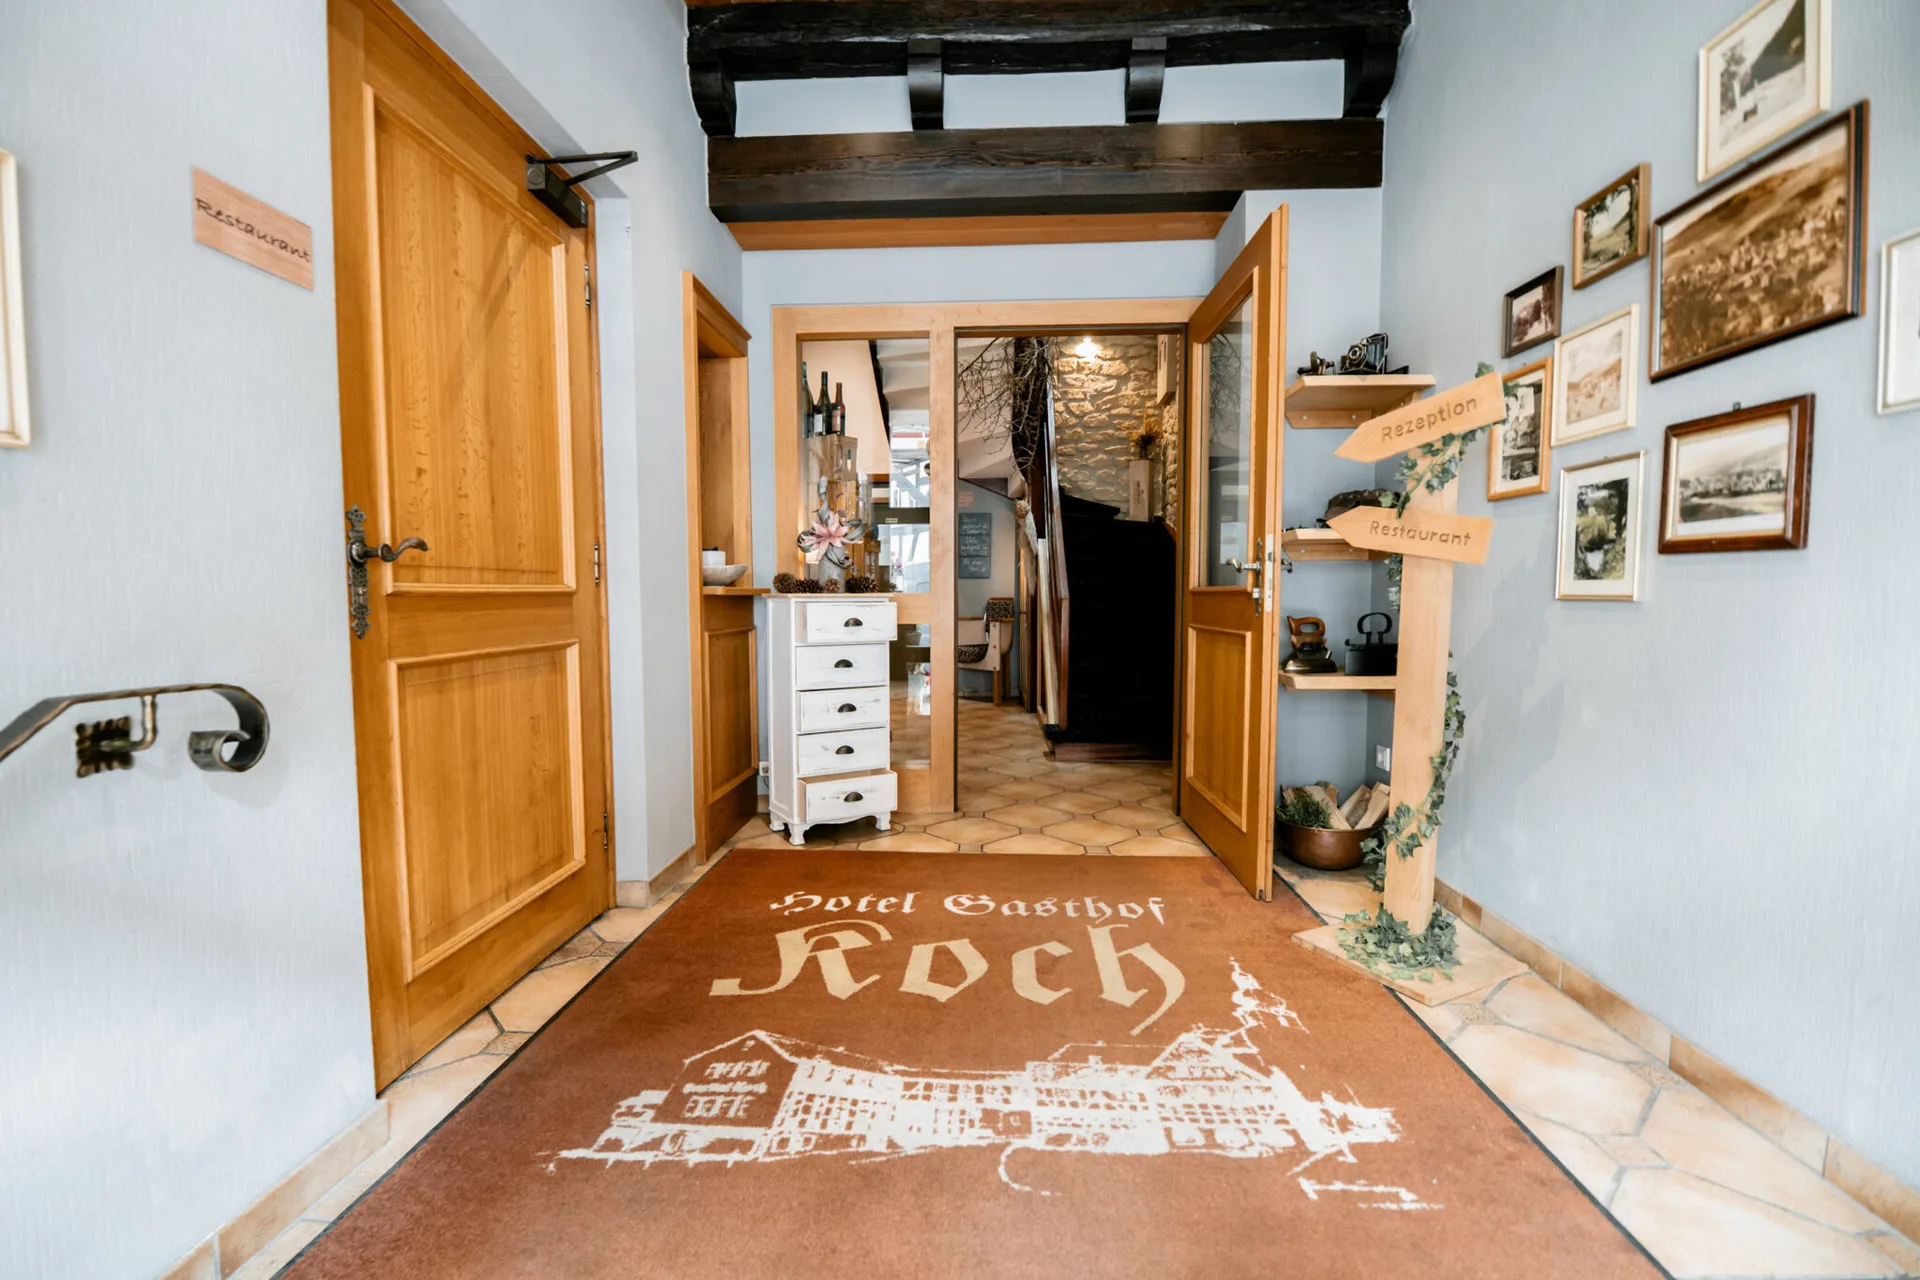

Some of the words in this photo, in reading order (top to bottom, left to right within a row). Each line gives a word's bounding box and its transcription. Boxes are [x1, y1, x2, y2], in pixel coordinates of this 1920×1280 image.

[195, 198, 311, 262] Restaurant
[1381, 398, 1477, 442] Rezeption
[1369, 520, 1471, 546] Restaurant
[769, 891, 921, 916] Hotel
[943, 894, 1165, 925] Gasthof
[709, 919, 1186, 1036] Koch
